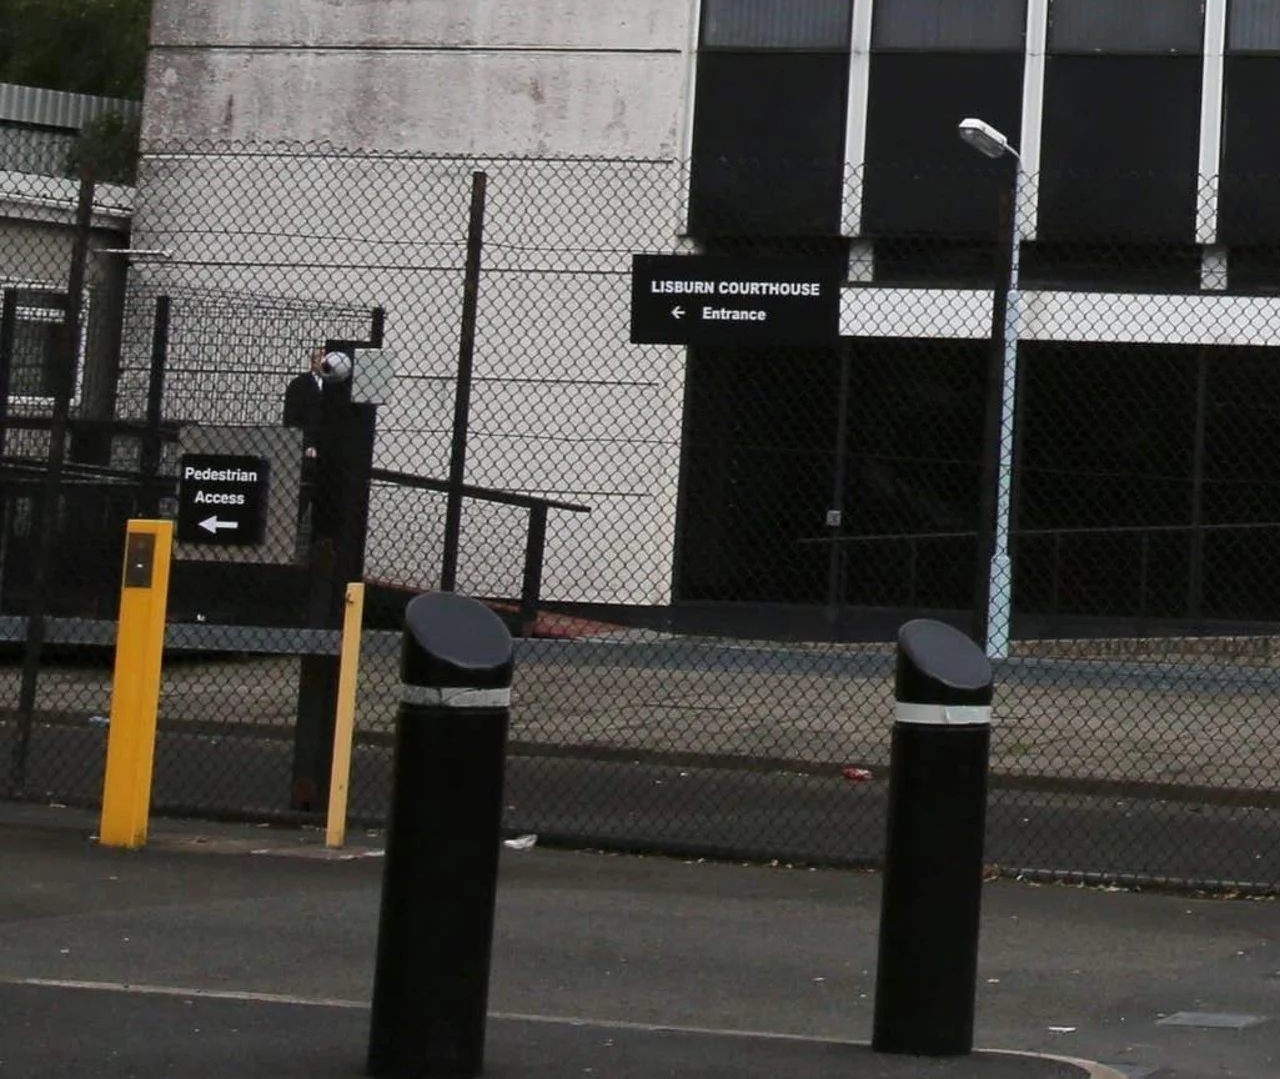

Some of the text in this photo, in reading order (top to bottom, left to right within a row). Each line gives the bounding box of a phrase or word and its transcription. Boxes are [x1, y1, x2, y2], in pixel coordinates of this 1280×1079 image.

[651, 280, 820, 296] LISBURN COURTHOUSE
[702, 306, 767, 321] Entrance
[184, 466, 258, 482] Pedestrian
[194, 490, 245, 505] Access
